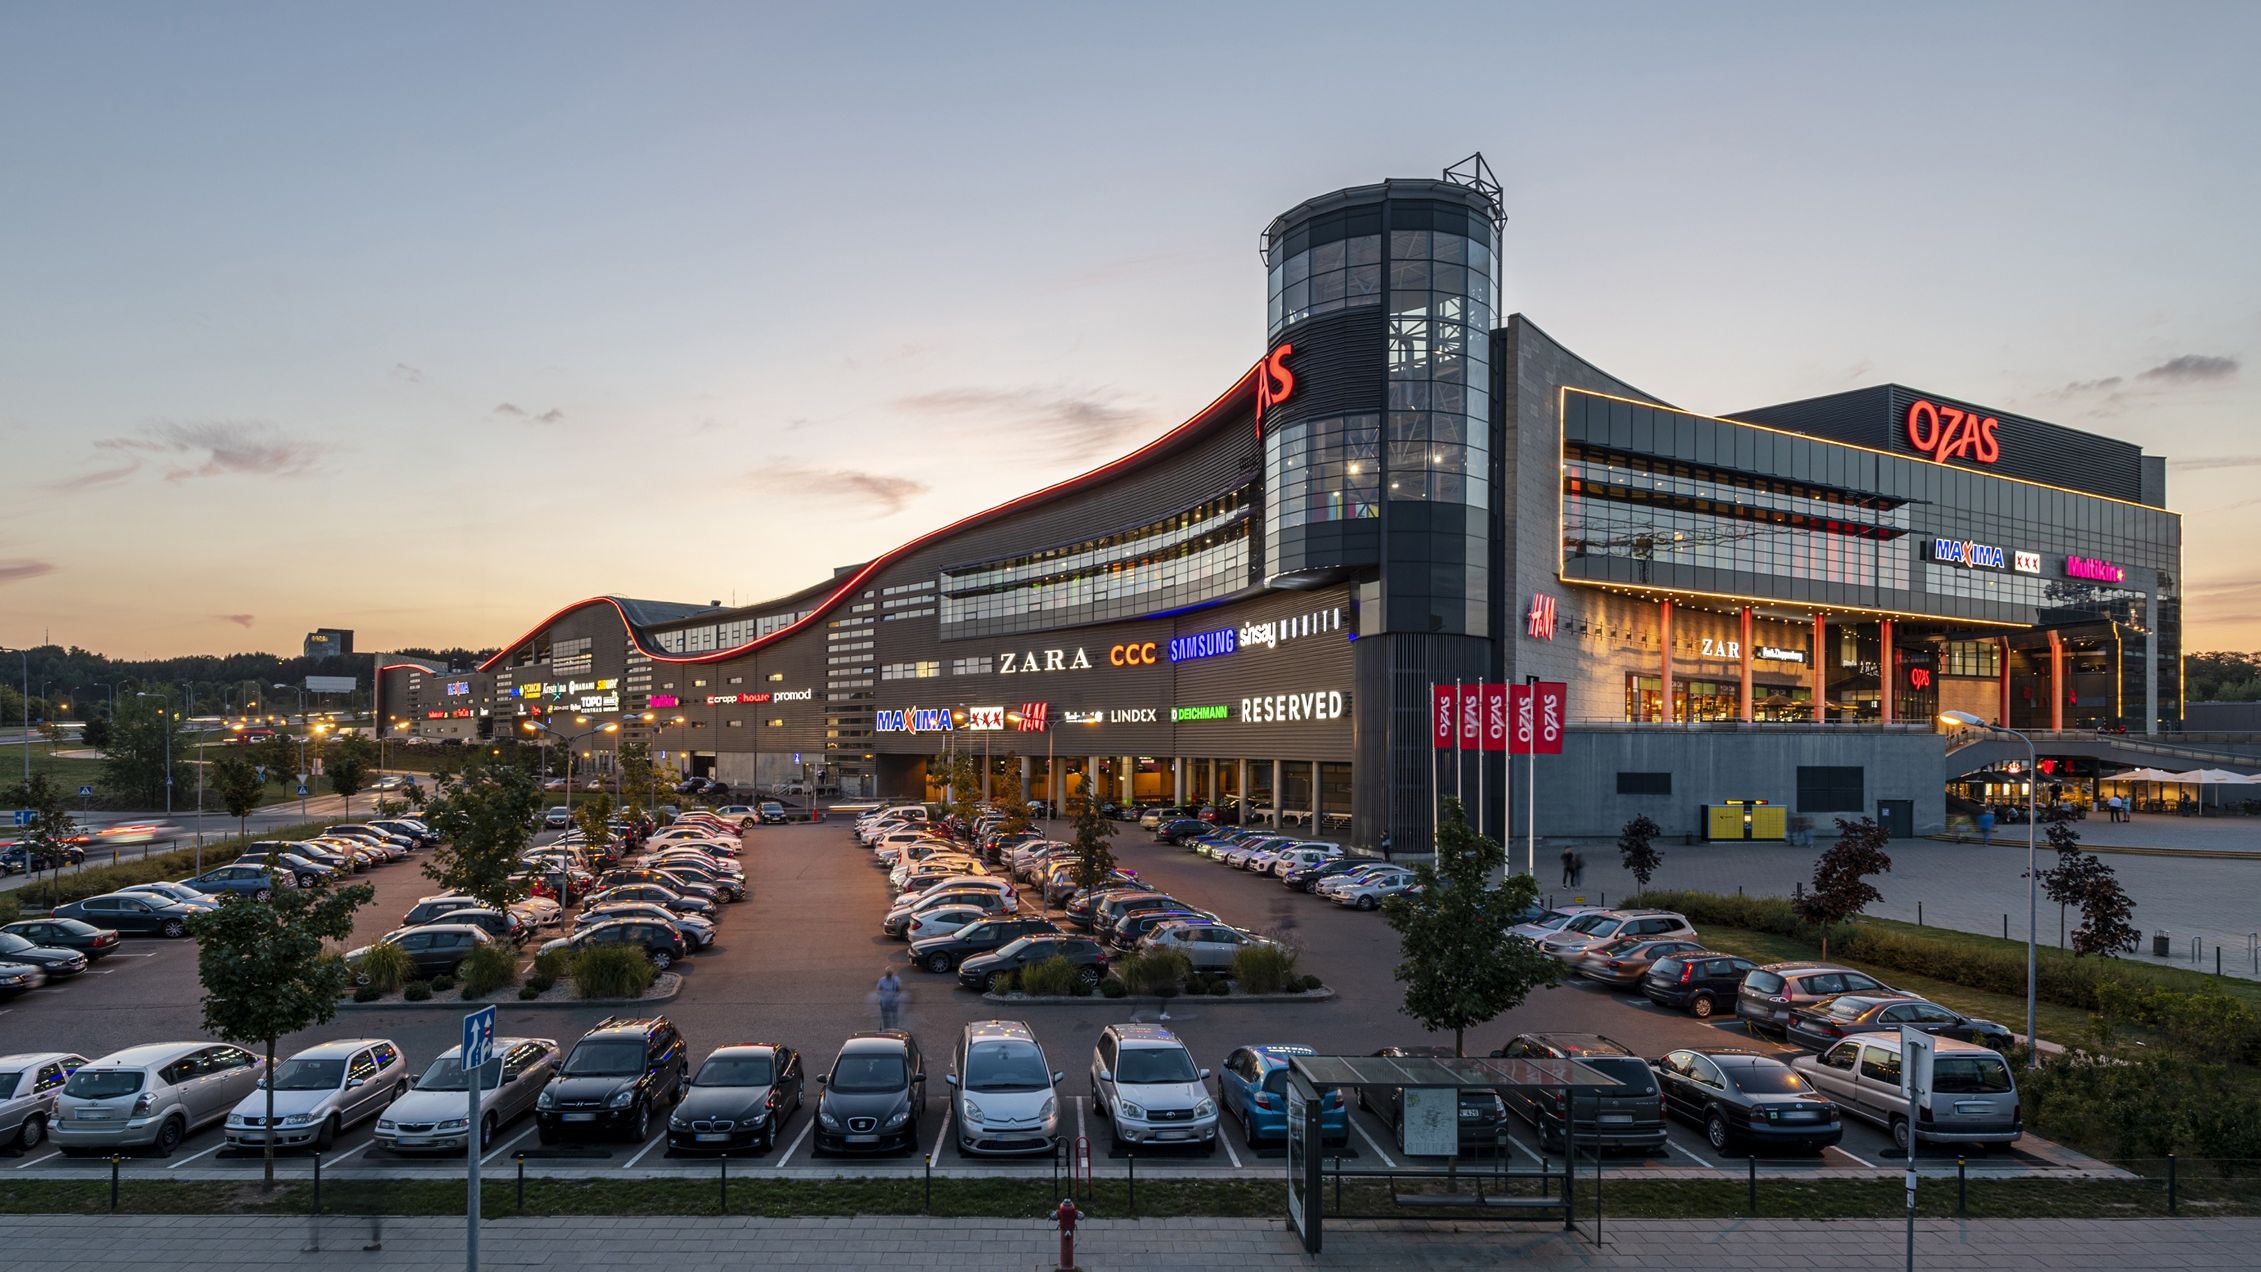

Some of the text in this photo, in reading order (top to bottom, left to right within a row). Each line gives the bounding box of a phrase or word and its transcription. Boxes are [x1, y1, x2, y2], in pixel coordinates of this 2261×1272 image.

[1908, 400, 1999, 464] OZAS
[1935, 538, 2005, 568] MAXIMA
[1529, 593, 1556, 640] H&M
[1171, 629, 1235, 662] SAMSUNG
[1240, 622, 1276, 649] sinsay
[1701, 638, 1740, 659] ZAR
[1000, 647, 1093, 674] ZARA
[1110, 643, 1156, 666] CCC
[1911, 668, 1931, 691] OZAS
[581, 695, 602, 707] TOPO
[774, 688, 812, 703] promod
[1241, 691, 1342, 722] RESERVED
[877, 706, 953, 735] MAXIMA
[1110, 708, 1157, 723] LINDEX
[1178, 705, 1228, 721] DEICHMANN
[1440, 696, 1451, 737] OZAS
[1490, 695, 1506, 739] OZAS
[1544, 694, 1560, 741] OZAS
